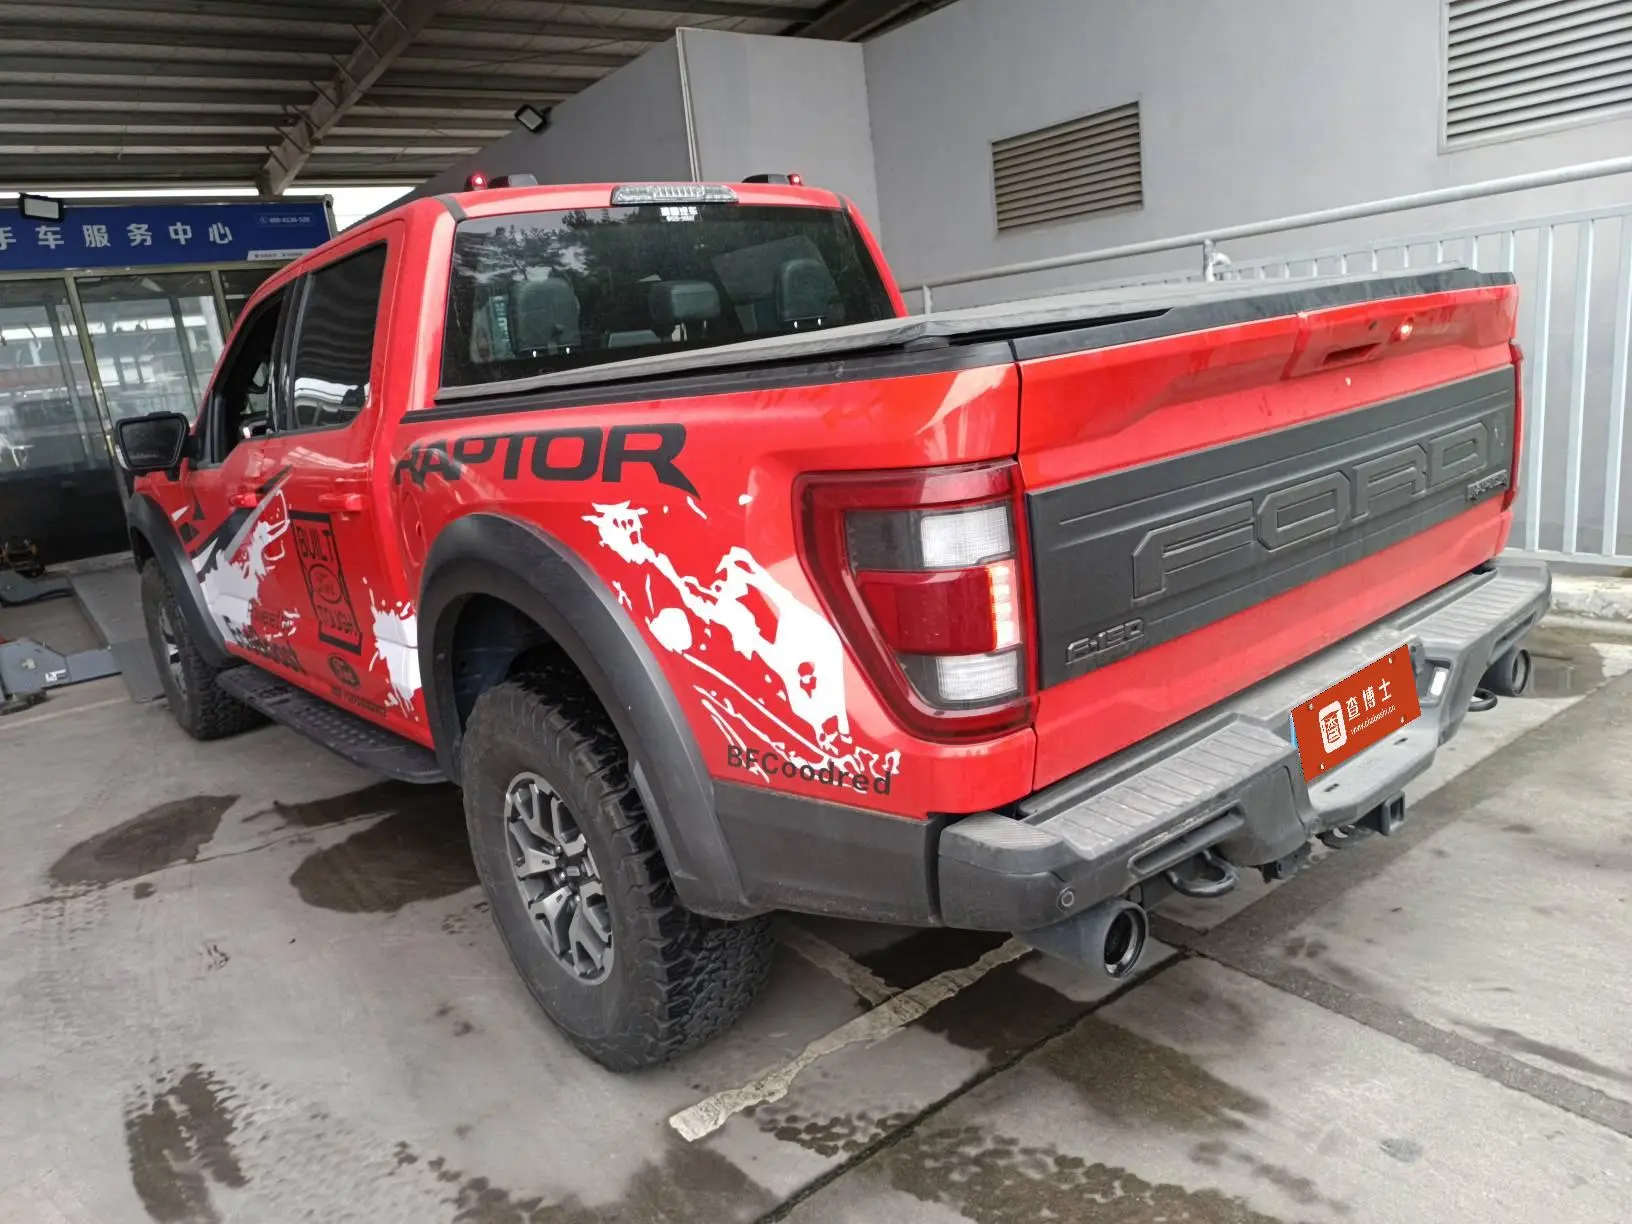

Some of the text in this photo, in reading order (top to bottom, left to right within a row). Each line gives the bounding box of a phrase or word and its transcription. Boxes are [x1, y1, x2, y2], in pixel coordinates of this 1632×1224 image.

[395, 422, 702, 500] RAPTOR
[1131, 420, 1488, 602] FORD
[295, 525, 335, 563] BUILT
[1065, 617, 1144, 664] F-150
